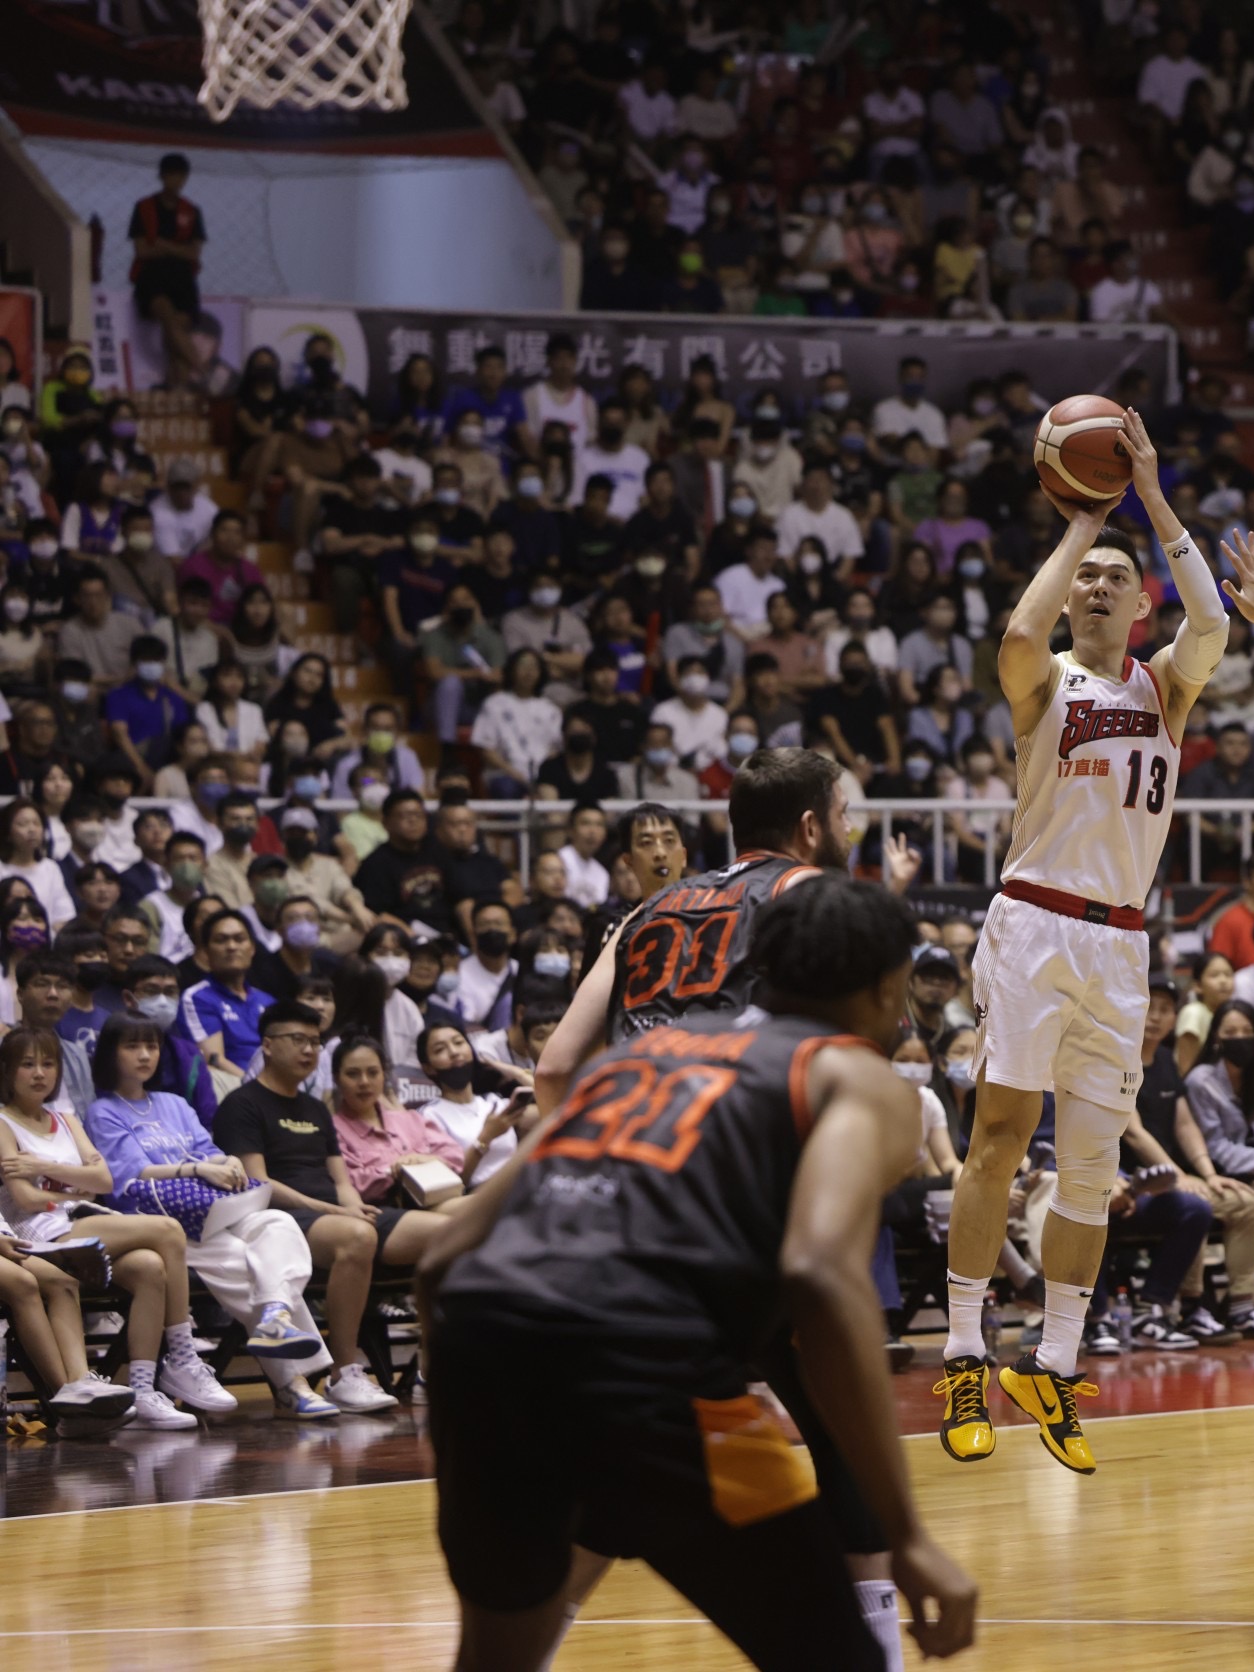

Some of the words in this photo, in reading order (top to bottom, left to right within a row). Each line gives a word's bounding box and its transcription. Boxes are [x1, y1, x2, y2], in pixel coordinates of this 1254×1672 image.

[1057, 758, 1111, 778] 17直播
[1122, 749, 1168, 816] 13
[623, 912, 743, 1010] 31
